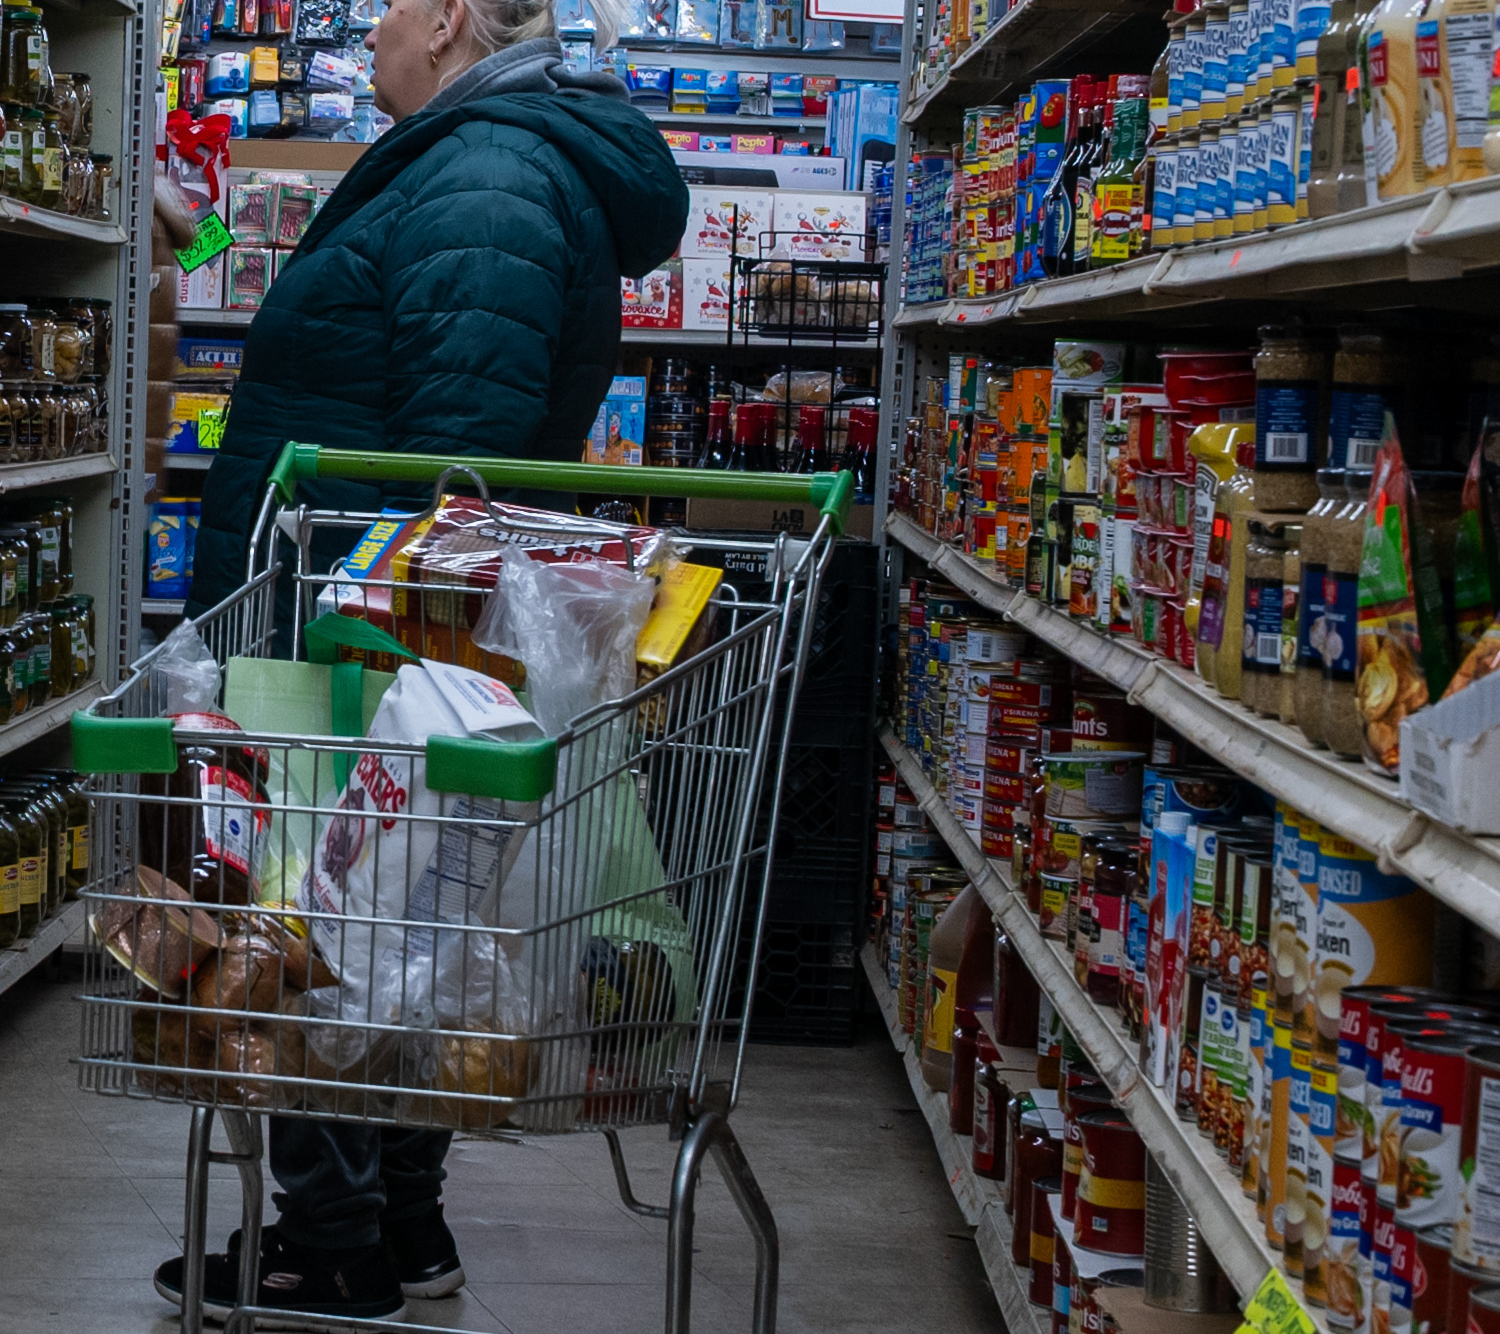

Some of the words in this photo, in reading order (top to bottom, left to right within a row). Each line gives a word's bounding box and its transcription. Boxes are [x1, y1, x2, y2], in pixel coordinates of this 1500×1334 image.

[637, 71, 660, 81] NyQuil
[737, 136, 766, 148] Pepto
[347, 539, 379, 570] LARGE
[375, 520, 400, 548] SIZE
